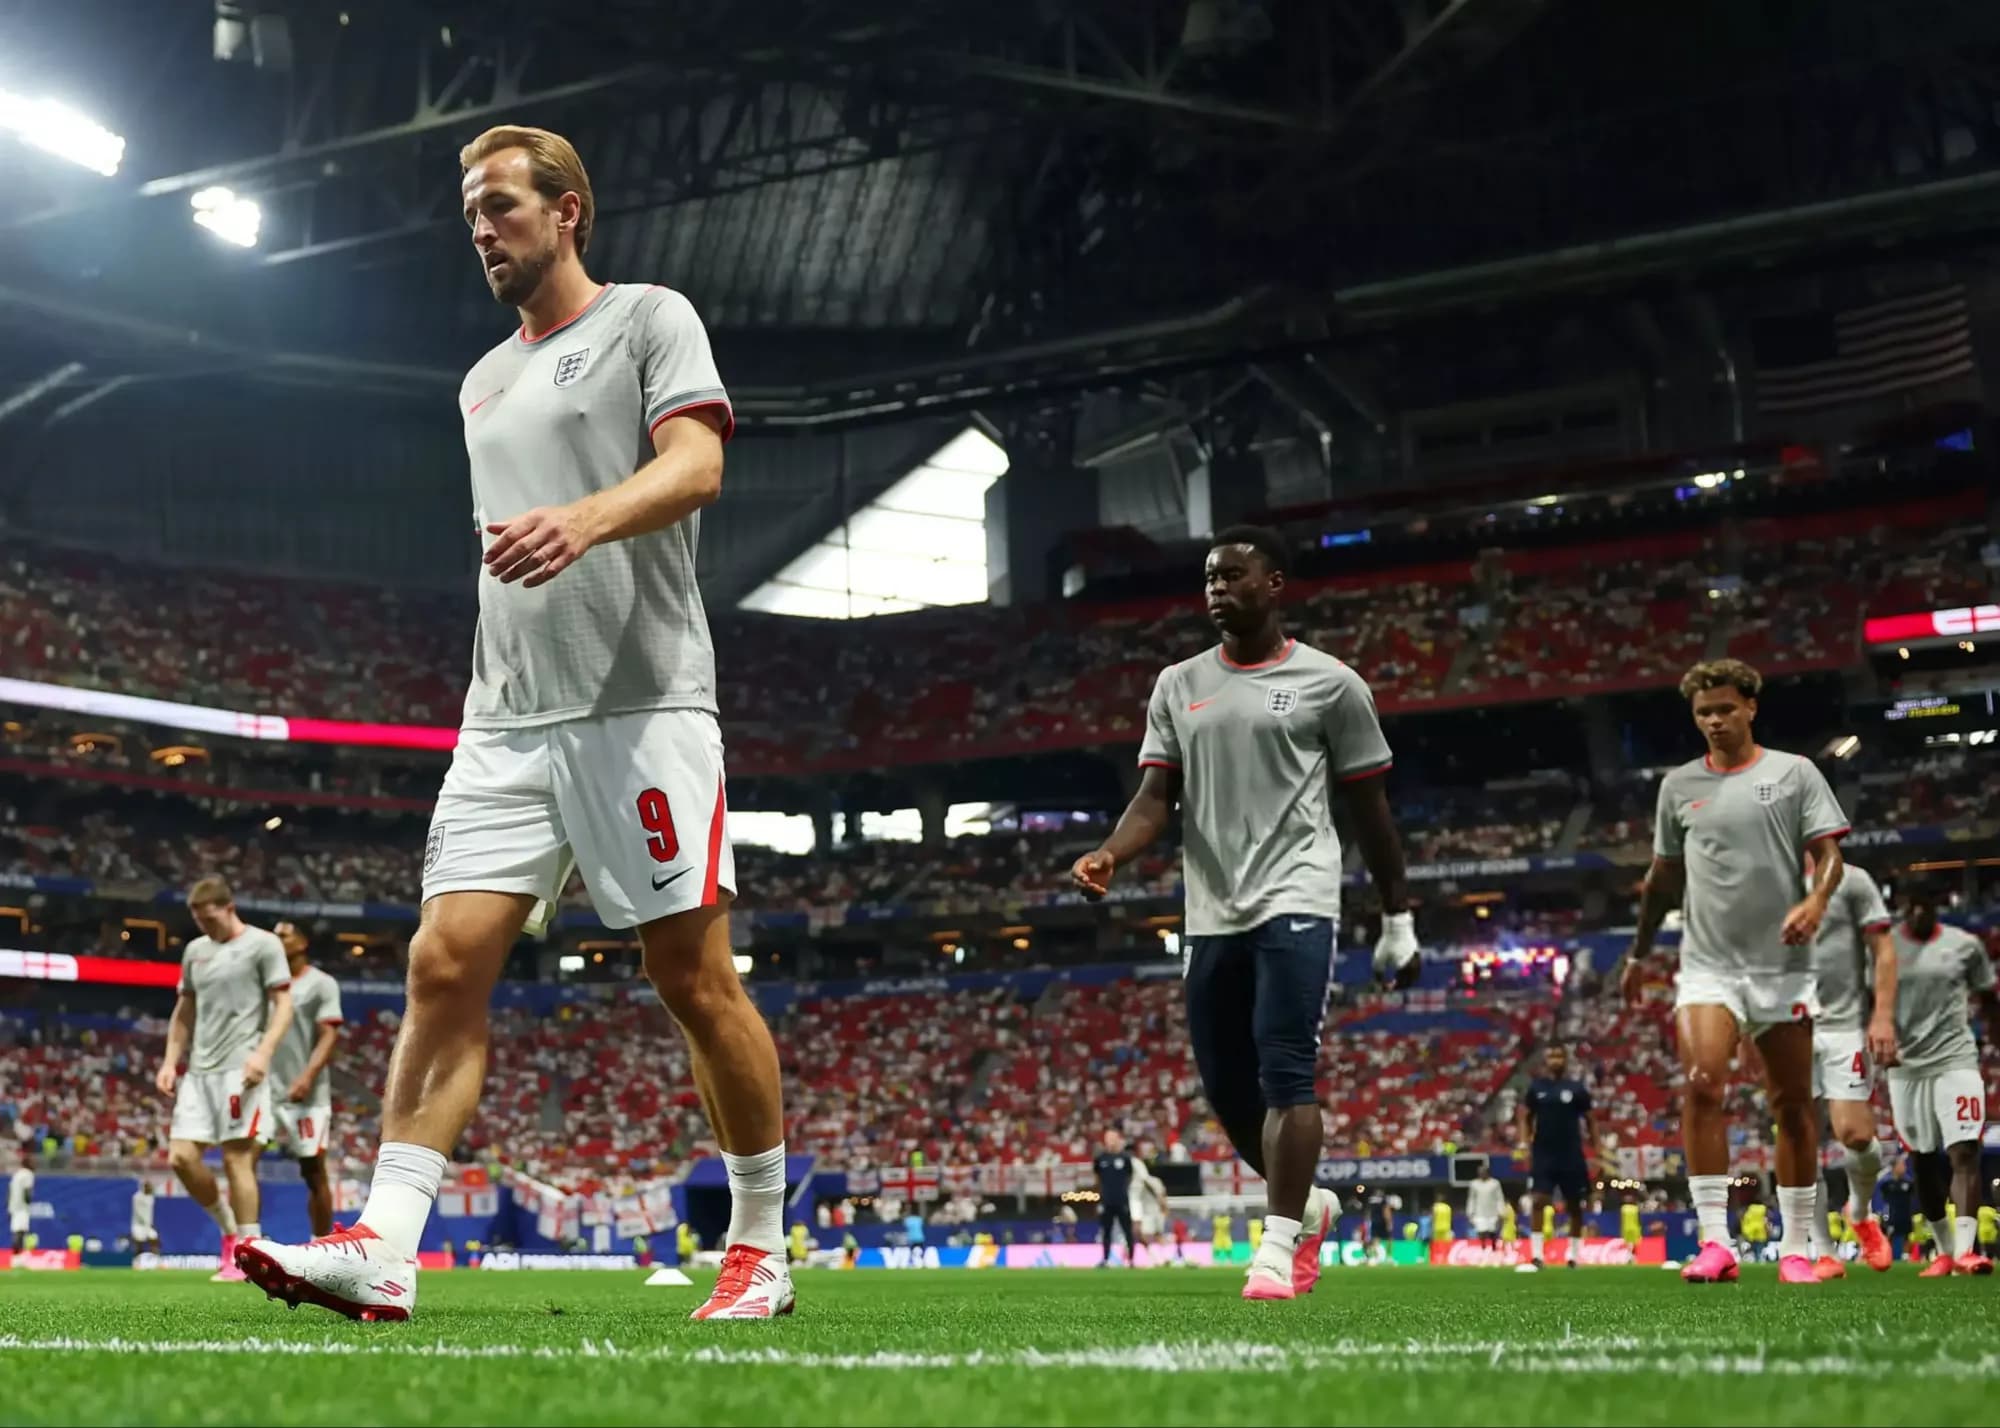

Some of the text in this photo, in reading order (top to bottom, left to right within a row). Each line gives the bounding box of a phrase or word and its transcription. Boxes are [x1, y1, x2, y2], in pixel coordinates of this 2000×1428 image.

[636, 787, 680, 863] 9
[1852, 1051, 1867, 1080] 4
[1955, 1095, 1982, 1122] 20
[1315, 1159, 1431, 1181] CUP 2026
[880, 1245, 941, 1269] VISA
